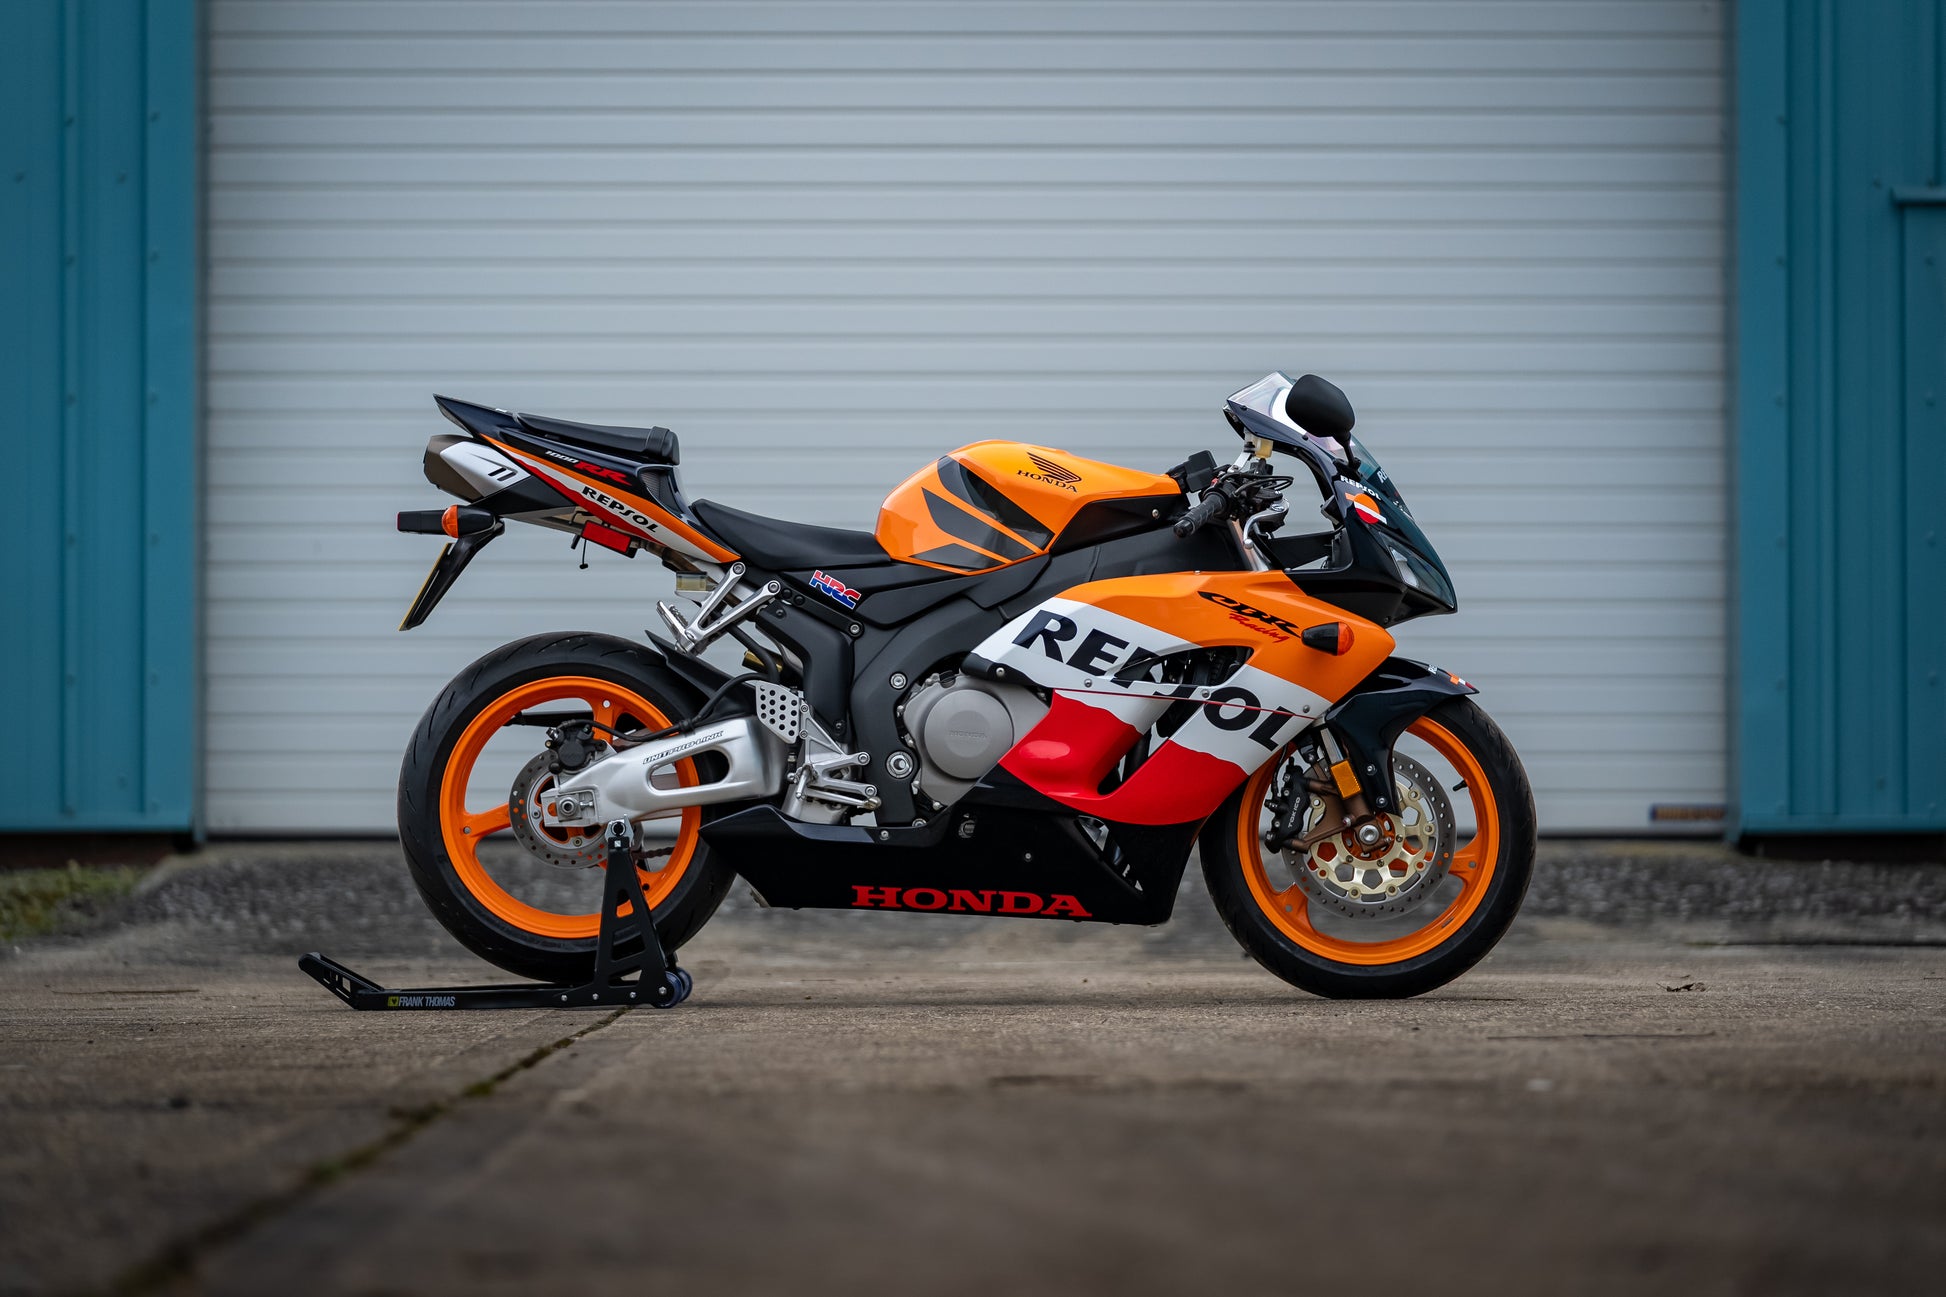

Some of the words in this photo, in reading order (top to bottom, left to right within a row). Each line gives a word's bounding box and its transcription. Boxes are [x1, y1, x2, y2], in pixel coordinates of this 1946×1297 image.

[1016, 469, 1078, 493] HONDA
[1340, 474, 1382, 501] REPSOL
[581, 485, 659, 533] REPSOL
[809, 569, 862, 610] HRC
[1197, 590, 1301, 639] CBR
[1229, 612, 1290, 644] Racing
[1287, 796, 1301, 829] TOKICO
[851, 885, 1093, 918] HONDA
[399, 996, 424, 1007] FRANK
[425, 996, 456, 1007] THOMAS
